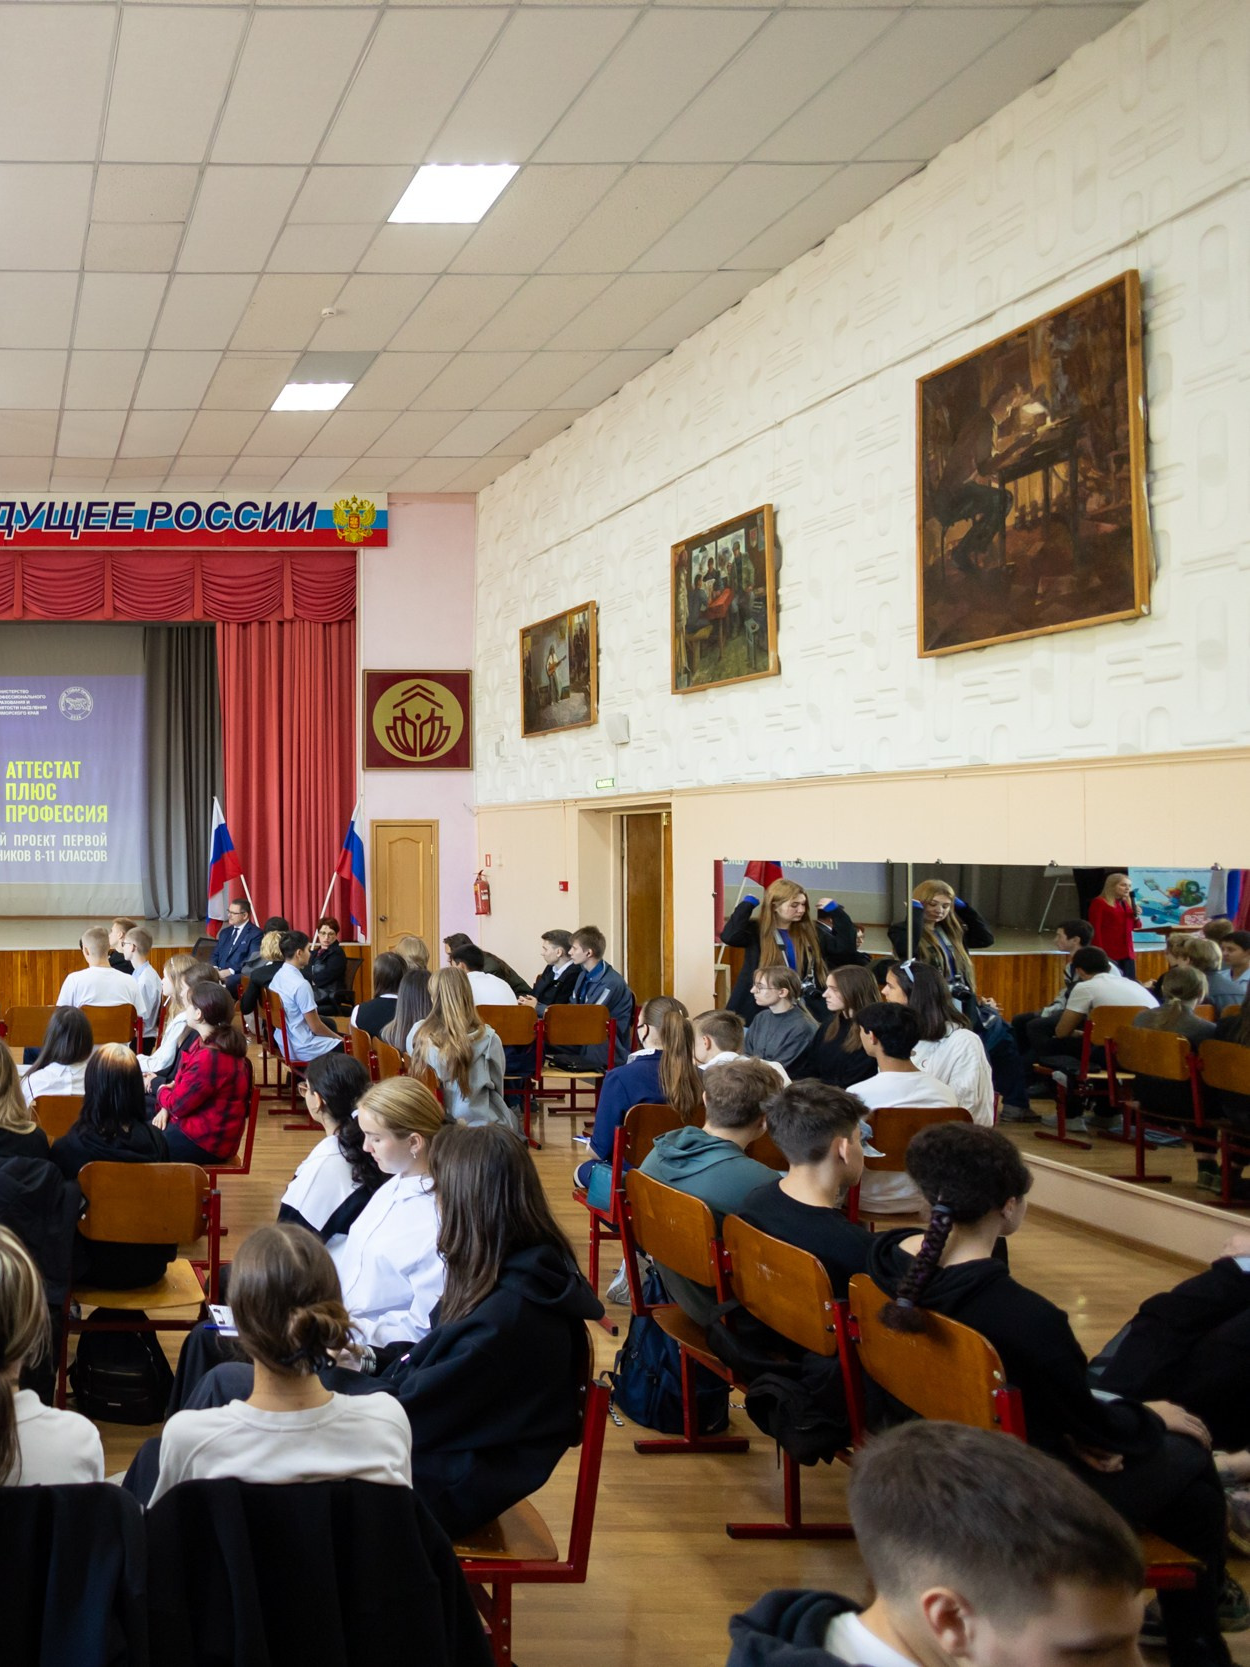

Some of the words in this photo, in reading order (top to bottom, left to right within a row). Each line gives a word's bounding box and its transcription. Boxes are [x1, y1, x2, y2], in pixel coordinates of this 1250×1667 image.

[144, 500, 319, 533] РОССИИ
[6, 761, 82, 779] АТТЕСТАТ
[5, 782, 57, 801] ПЛЮС
[5, 804, 108, 823] ПРОФЕССИЯ
[13, 834, 56, 847] ПРОЕКТ
[62, 832, 108, 847] ПЕРВОЙ
[34, 849, 55, 862] 8-11
[58, 849, 108, 862] КЛАССОВ
